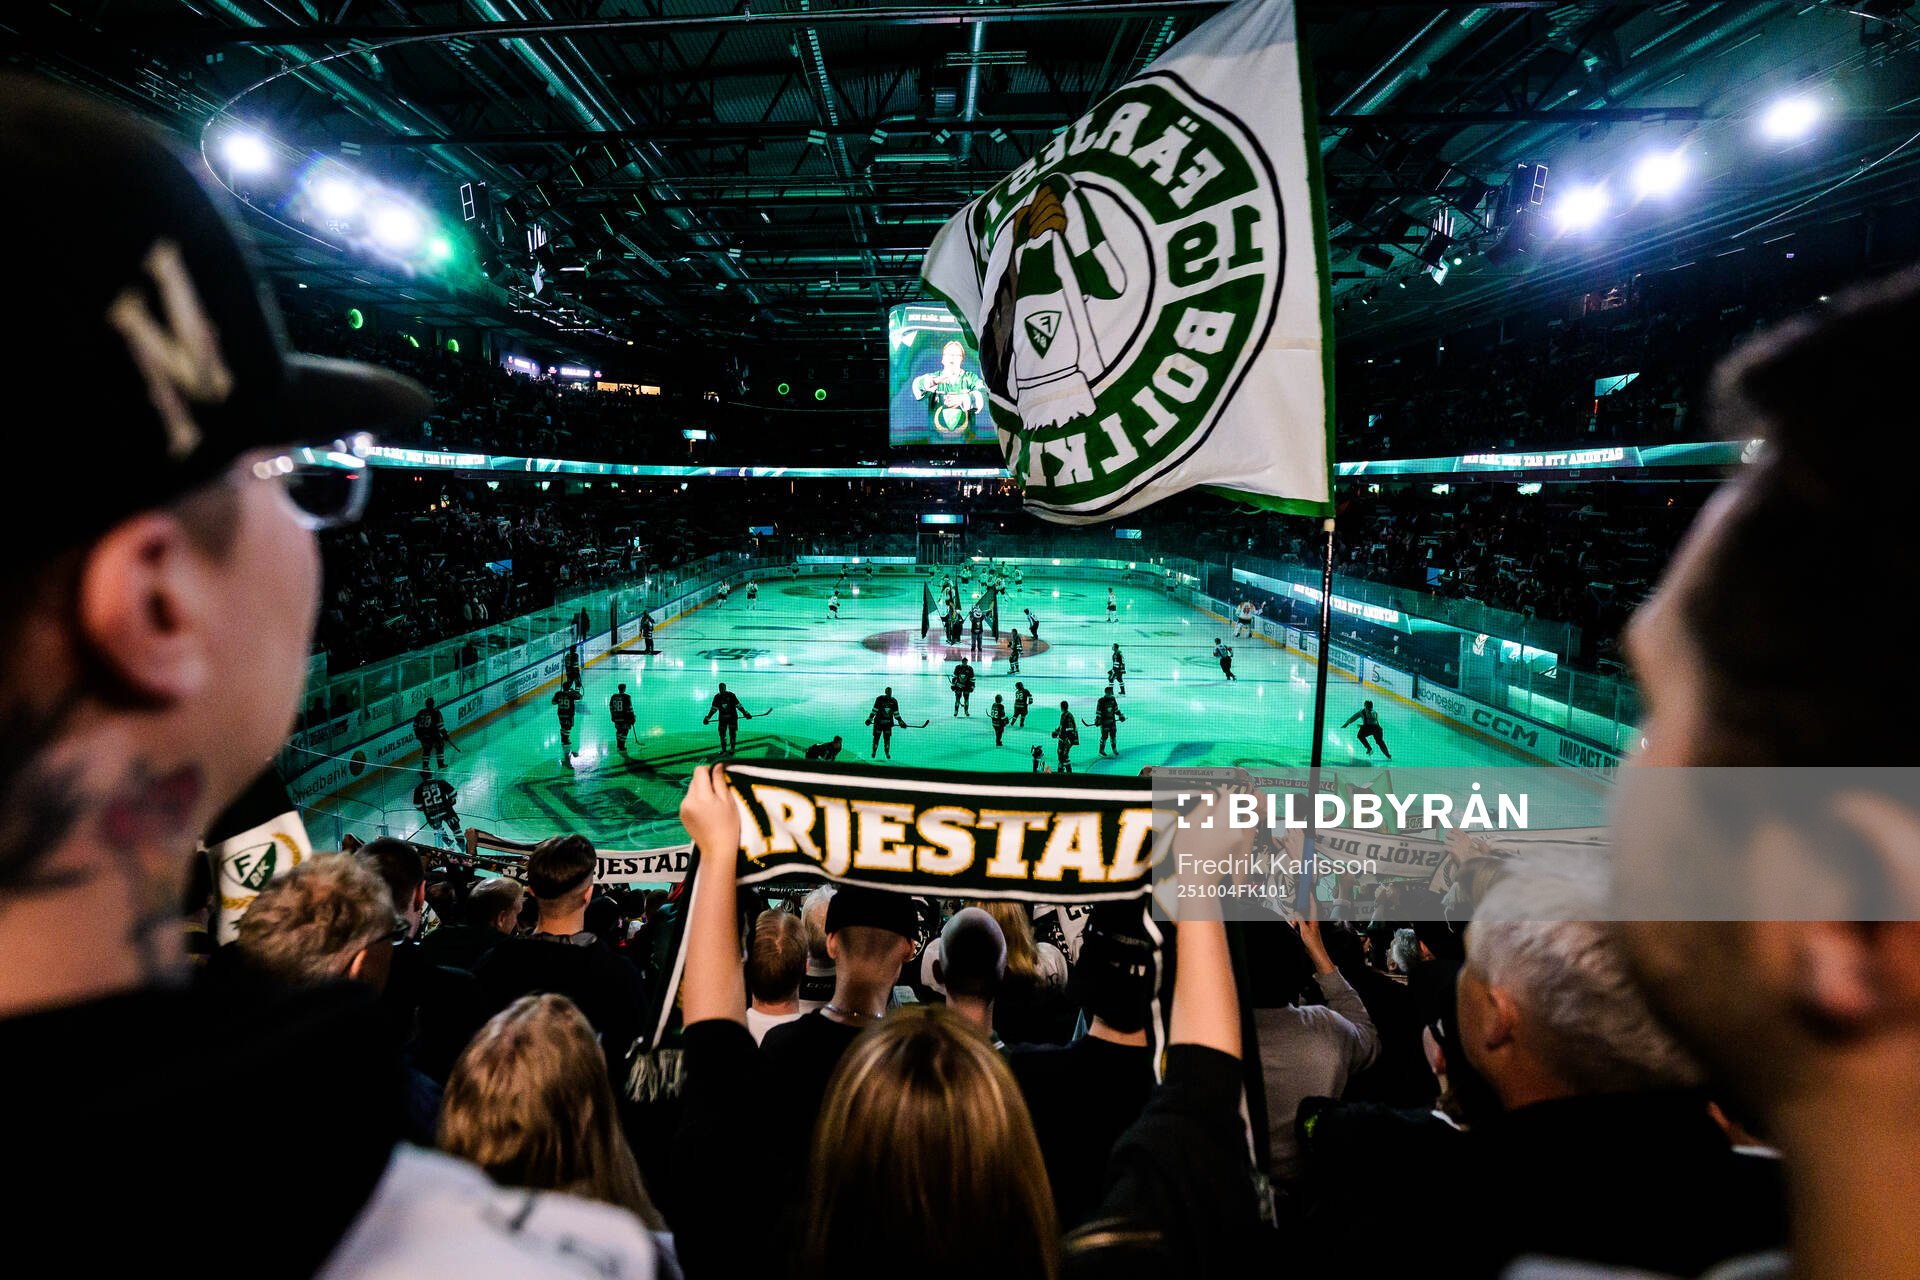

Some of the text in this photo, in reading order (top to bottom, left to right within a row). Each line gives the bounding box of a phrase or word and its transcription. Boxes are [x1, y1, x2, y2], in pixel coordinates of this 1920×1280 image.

[108, 238, 234, 458] N
[1471, 708, 1540, 749] CCM
[1559, 736, 1603, 774] IMPACT
[421, 787, 443, 807] 22
[594, 852, 691, 880] JESTAD
